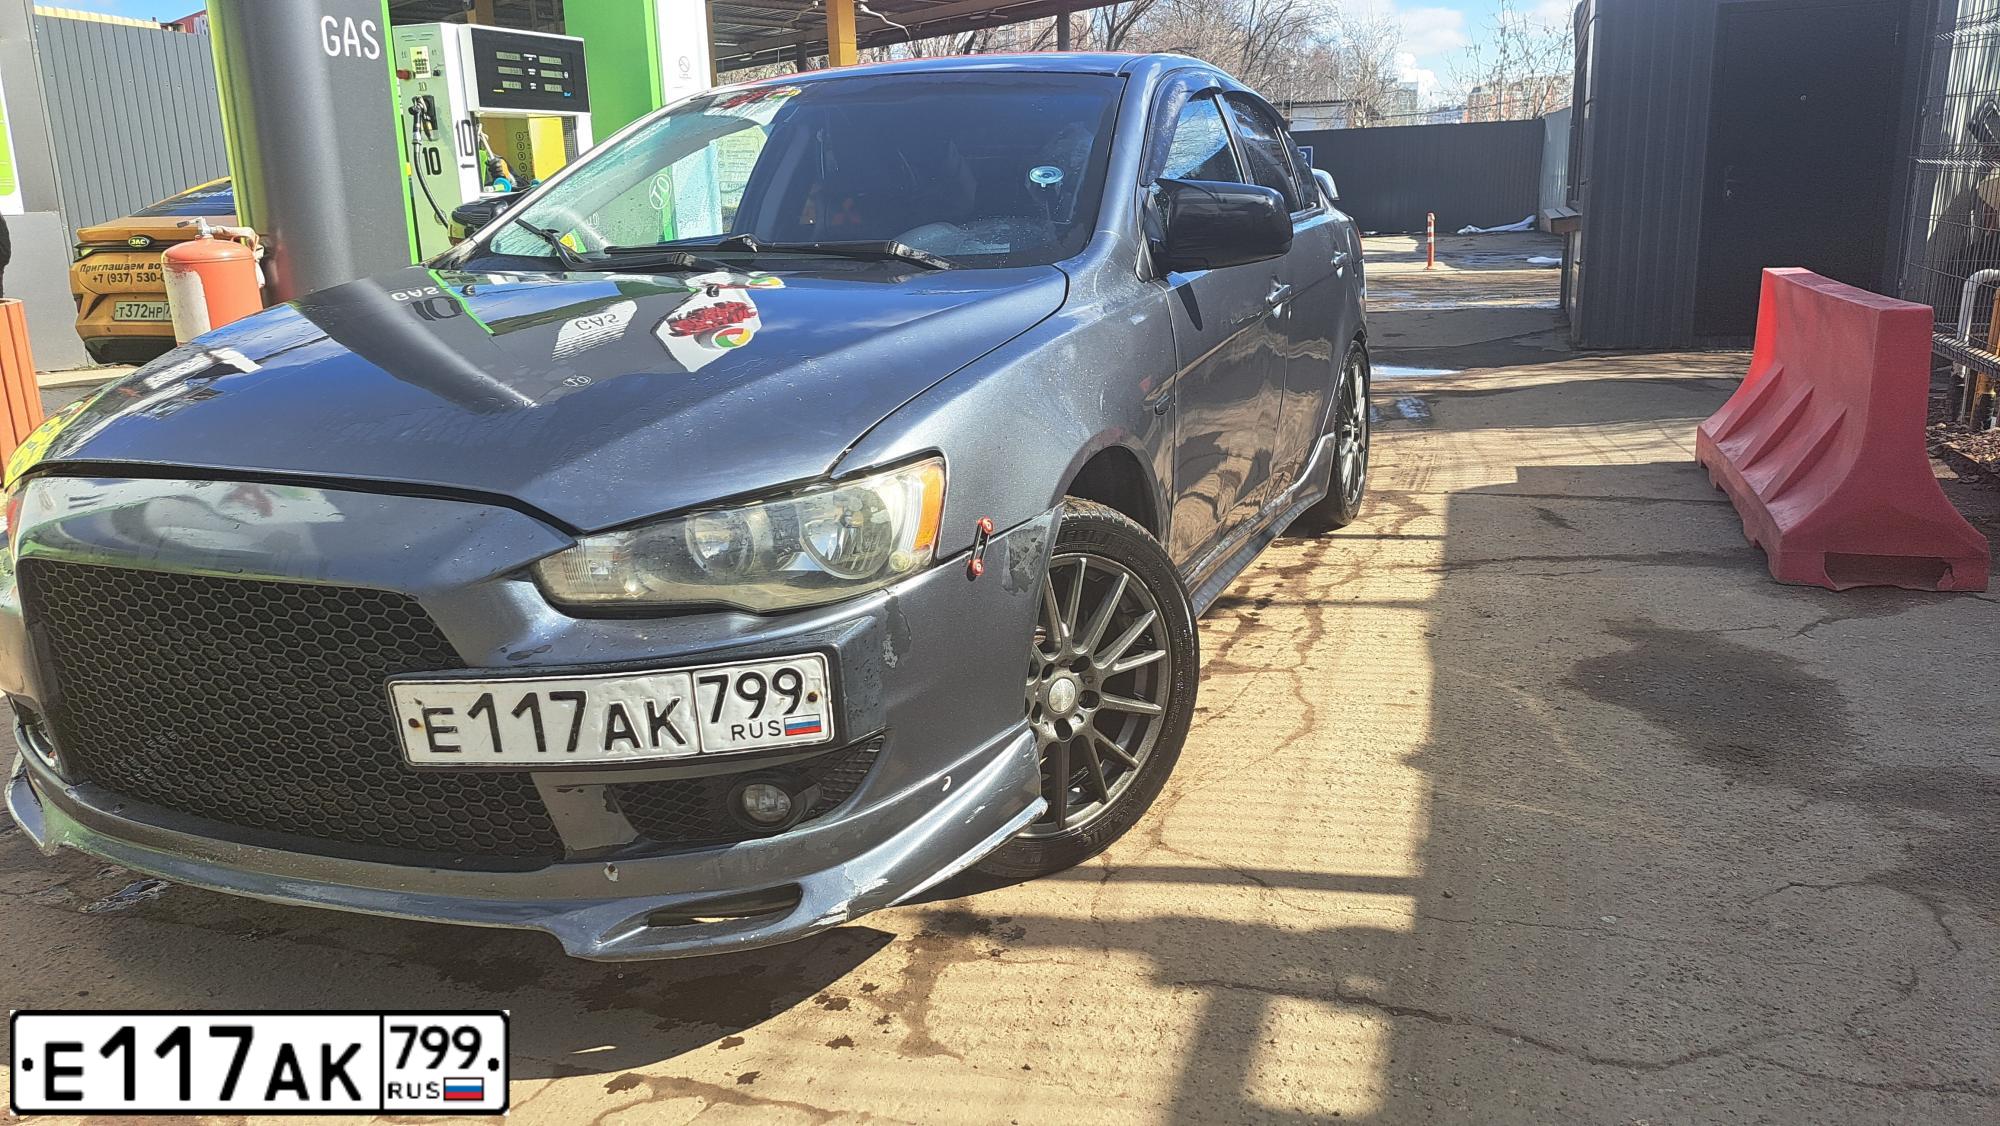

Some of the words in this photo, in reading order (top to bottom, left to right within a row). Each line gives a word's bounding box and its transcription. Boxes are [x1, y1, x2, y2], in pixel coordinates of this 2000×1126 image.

[321, 15, 380, 60] GAS
[455, 119, 474, 157] 10
[422, 146, 442, 176] 10
[80, 263, 145, 273] Приглашаем
[148, 262, 162, 271] во
[93, 274, 103, 283] +7
[107, 272, 133, 285] (937)
[118, 304, 163, 318] Т372НР
[422, 690, 688, 754] Е117АК
[698, 667, 803, 724] 799
[730, 719, 781, 741] RUS
